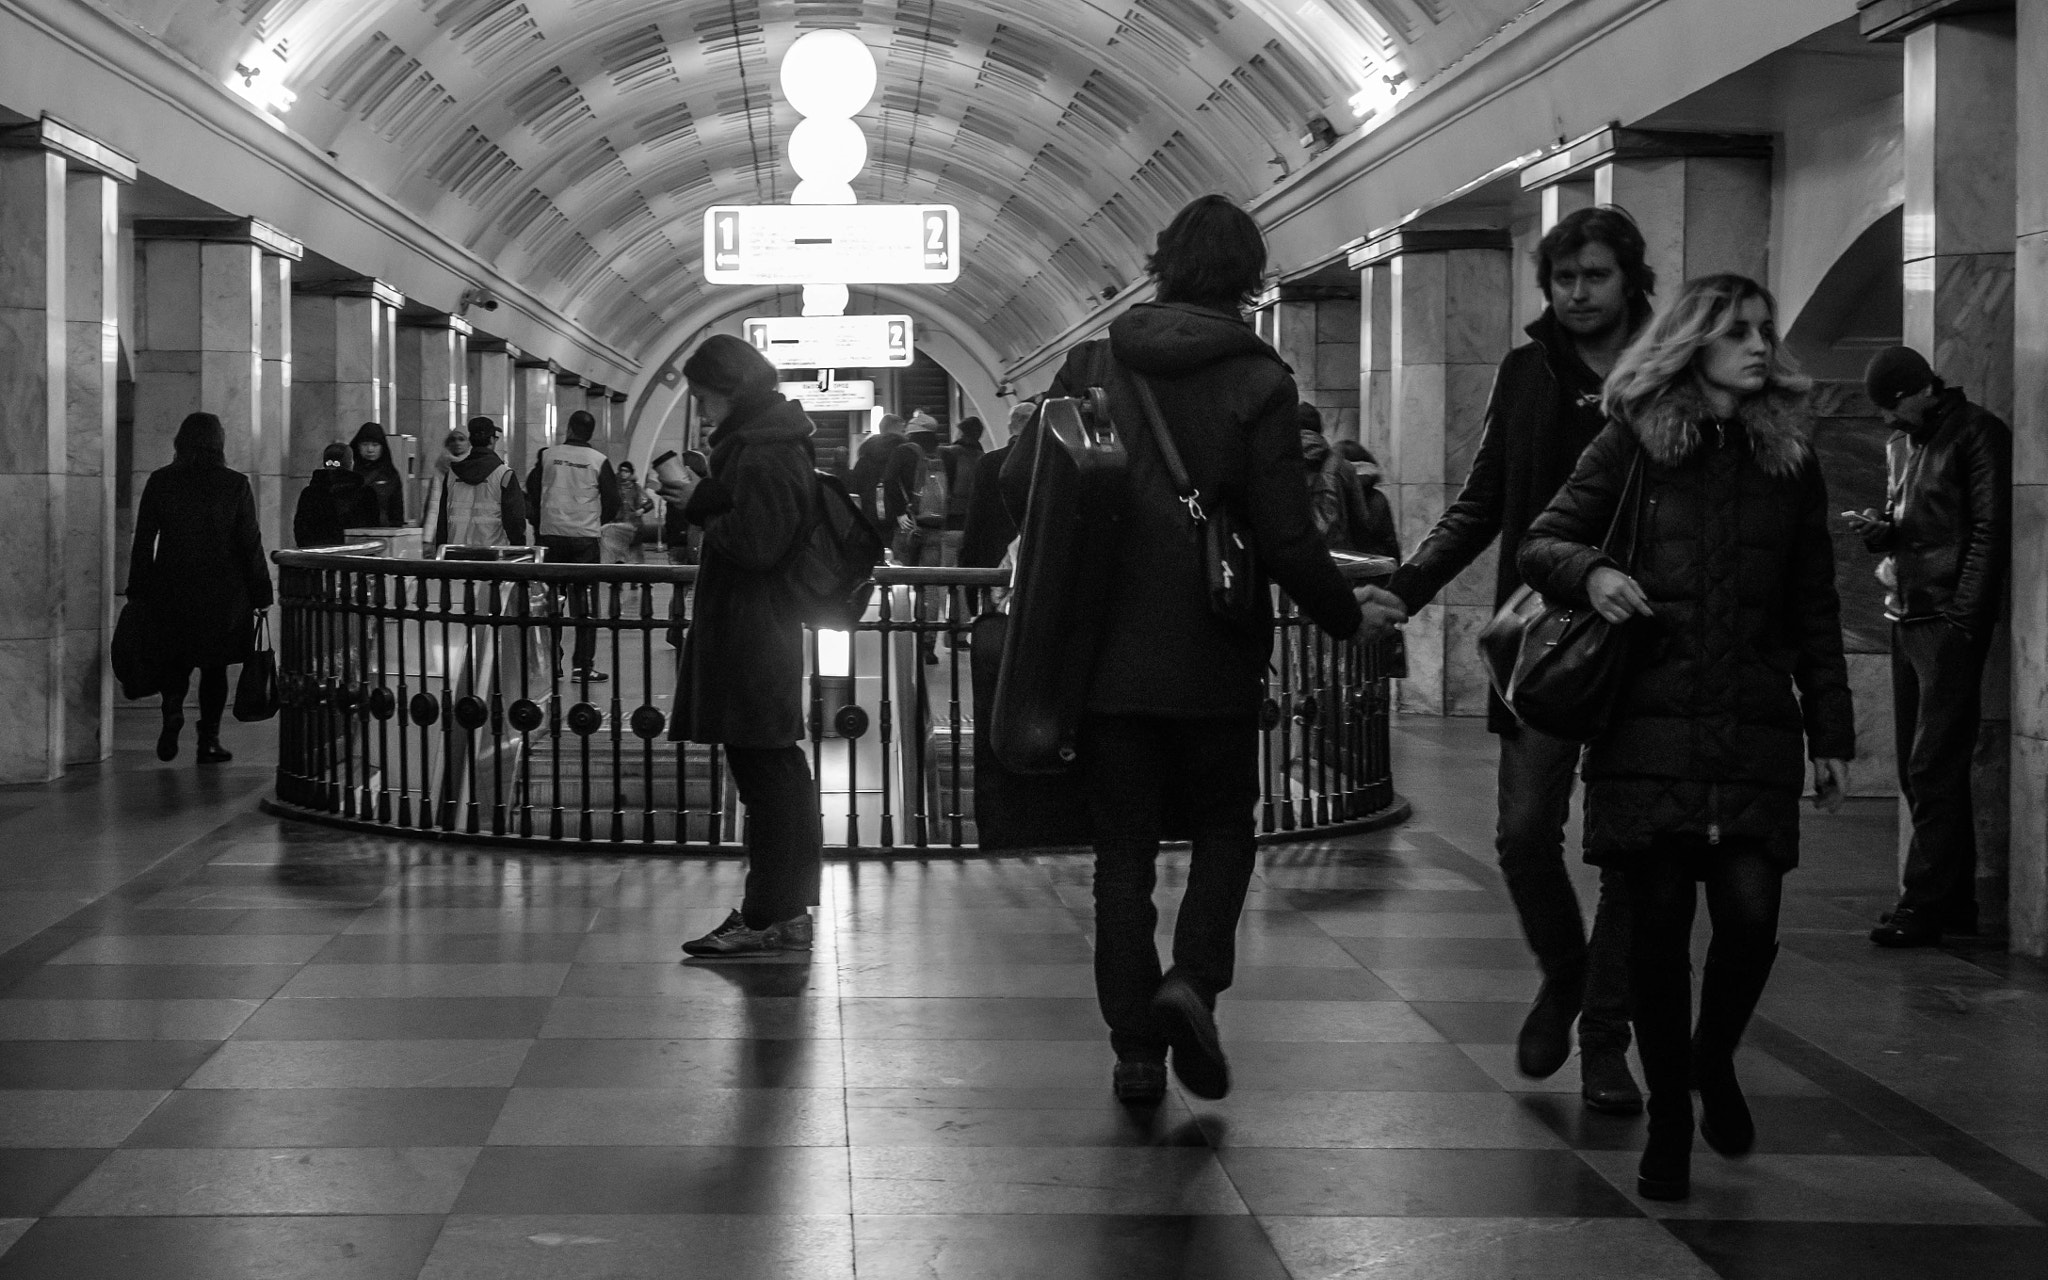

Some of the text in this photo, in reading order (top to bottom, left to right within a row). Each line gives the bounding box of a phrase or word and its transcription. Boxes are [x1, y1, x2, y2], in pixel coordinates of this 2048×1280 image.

[719, 217, 733, 249] 1
[927, 216, 944, 249] 2
[753, 328, 764, 348] 1
[890, 325, 903, 346] 2
